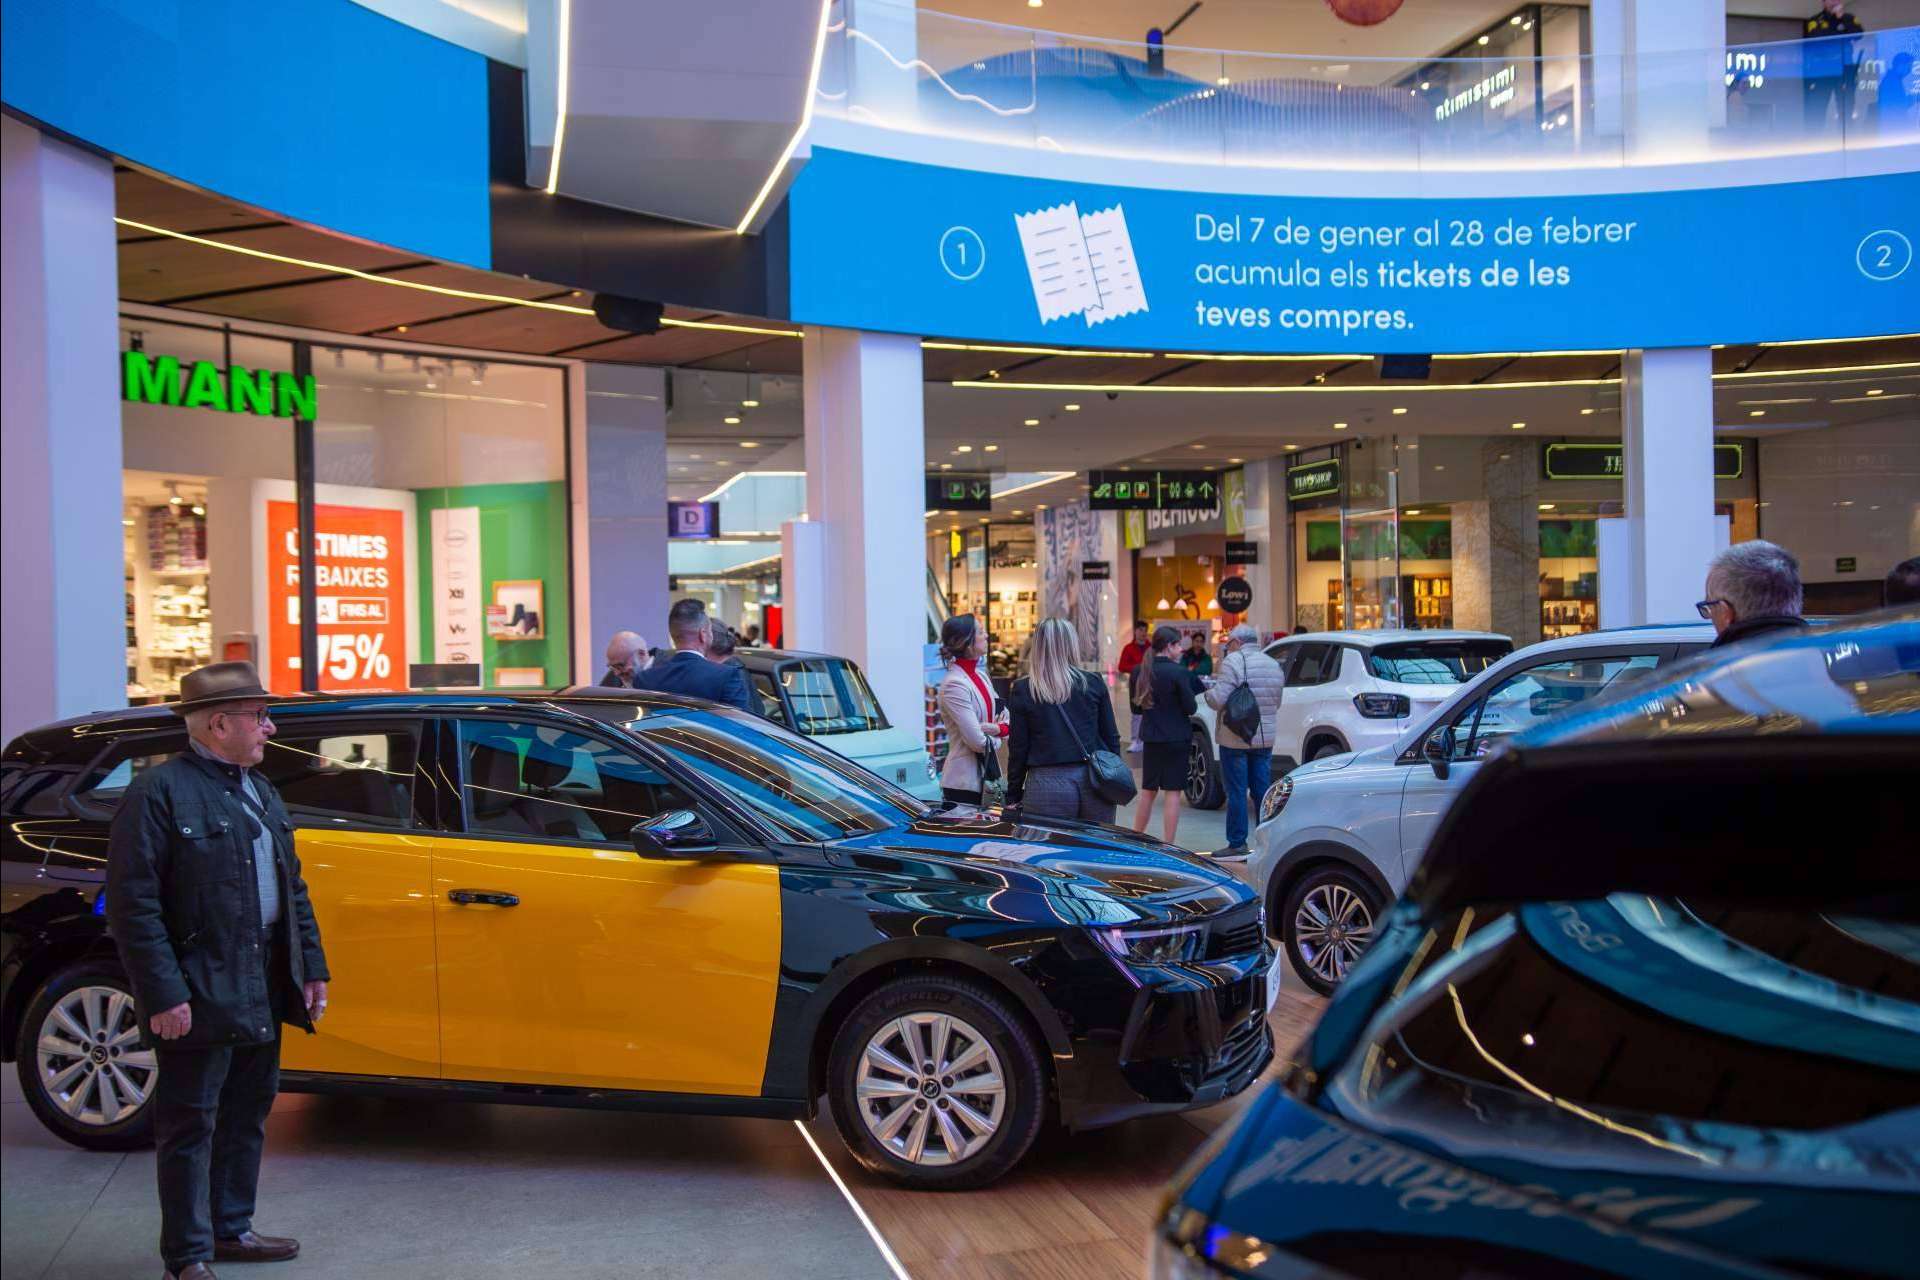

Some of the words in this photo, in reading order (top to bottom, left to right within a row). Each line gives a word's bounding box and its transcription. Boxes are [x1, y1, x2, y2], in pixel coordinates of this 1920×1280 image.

[1196, 213, 1240, 242] Del
[1250, 218, 1264, 242] 7
[1274, 217, 1310, 245] de
[1320, 226, 1405, 254] gener
[1414, 219, 1439, 247] al
[1450, 220, 1484, 246] 28
[1494, 218, 1532, 245] de
[1542, 216, 1636, 244] febrer
[958, 243, 965, 264] 1
[1877, 246, 1891, 267] 2
[1195, 259, 1320, 287] acumula
[1330, 260, 1368, 288] els
[1377, 260, 1471, 288] tickets
[1480, 260, 1519, 287] de
[1529, 258, 1570, 286] les
[1195, 301, 1271, 328] teves
[1279, 309, 1414, 336] compres.
[122, 350, 317, 421] MANN
[684, 511, 699, 525] D
[286, 529, 388, 560] ÚTIMES
[286, 565, 388, 588] RBAIXES
